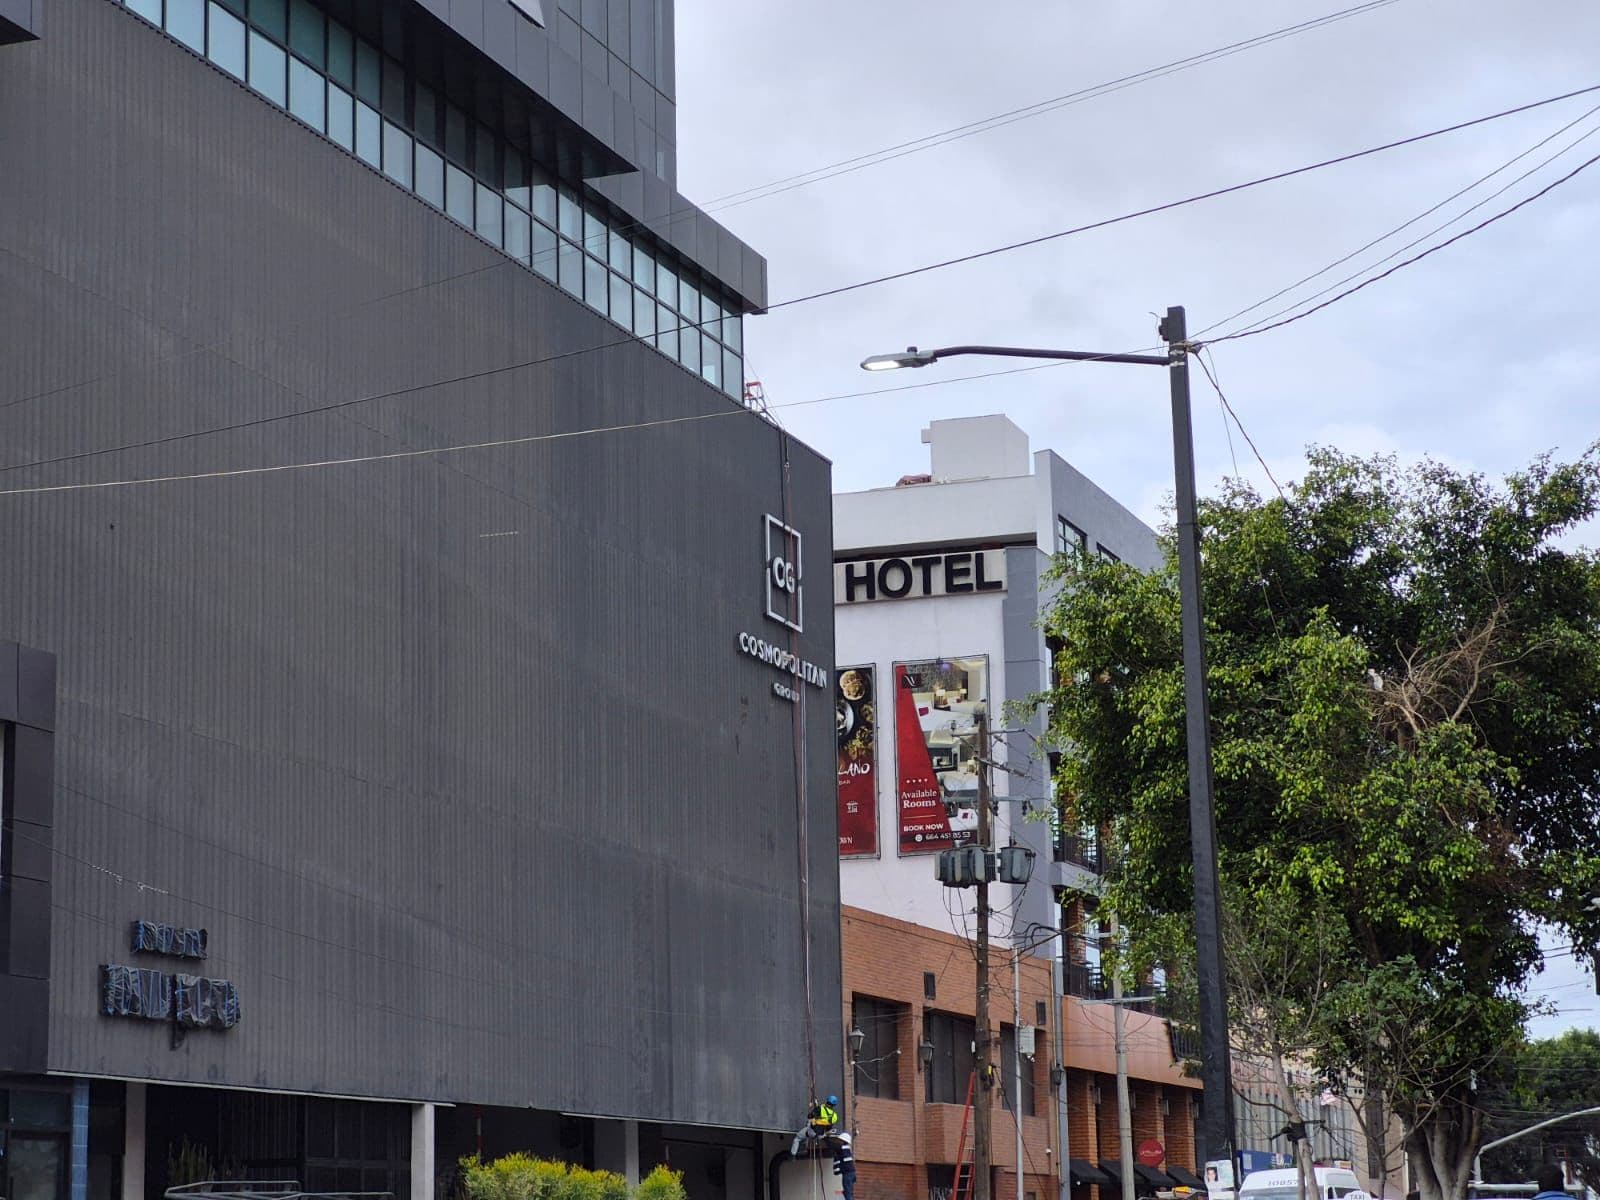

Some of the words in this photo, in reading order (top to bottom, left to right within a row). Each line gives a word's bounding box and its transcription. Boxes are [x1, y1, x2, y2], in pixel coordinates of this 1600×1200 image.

[773, 556, 795, 593] CG
[845, 552, 1003, 601] HOTEL
[739, 631, 827, 688] COSMOPOLITAN
[901, 789, 938, 799] Available
[903, 799, 936, 808] Rooms
